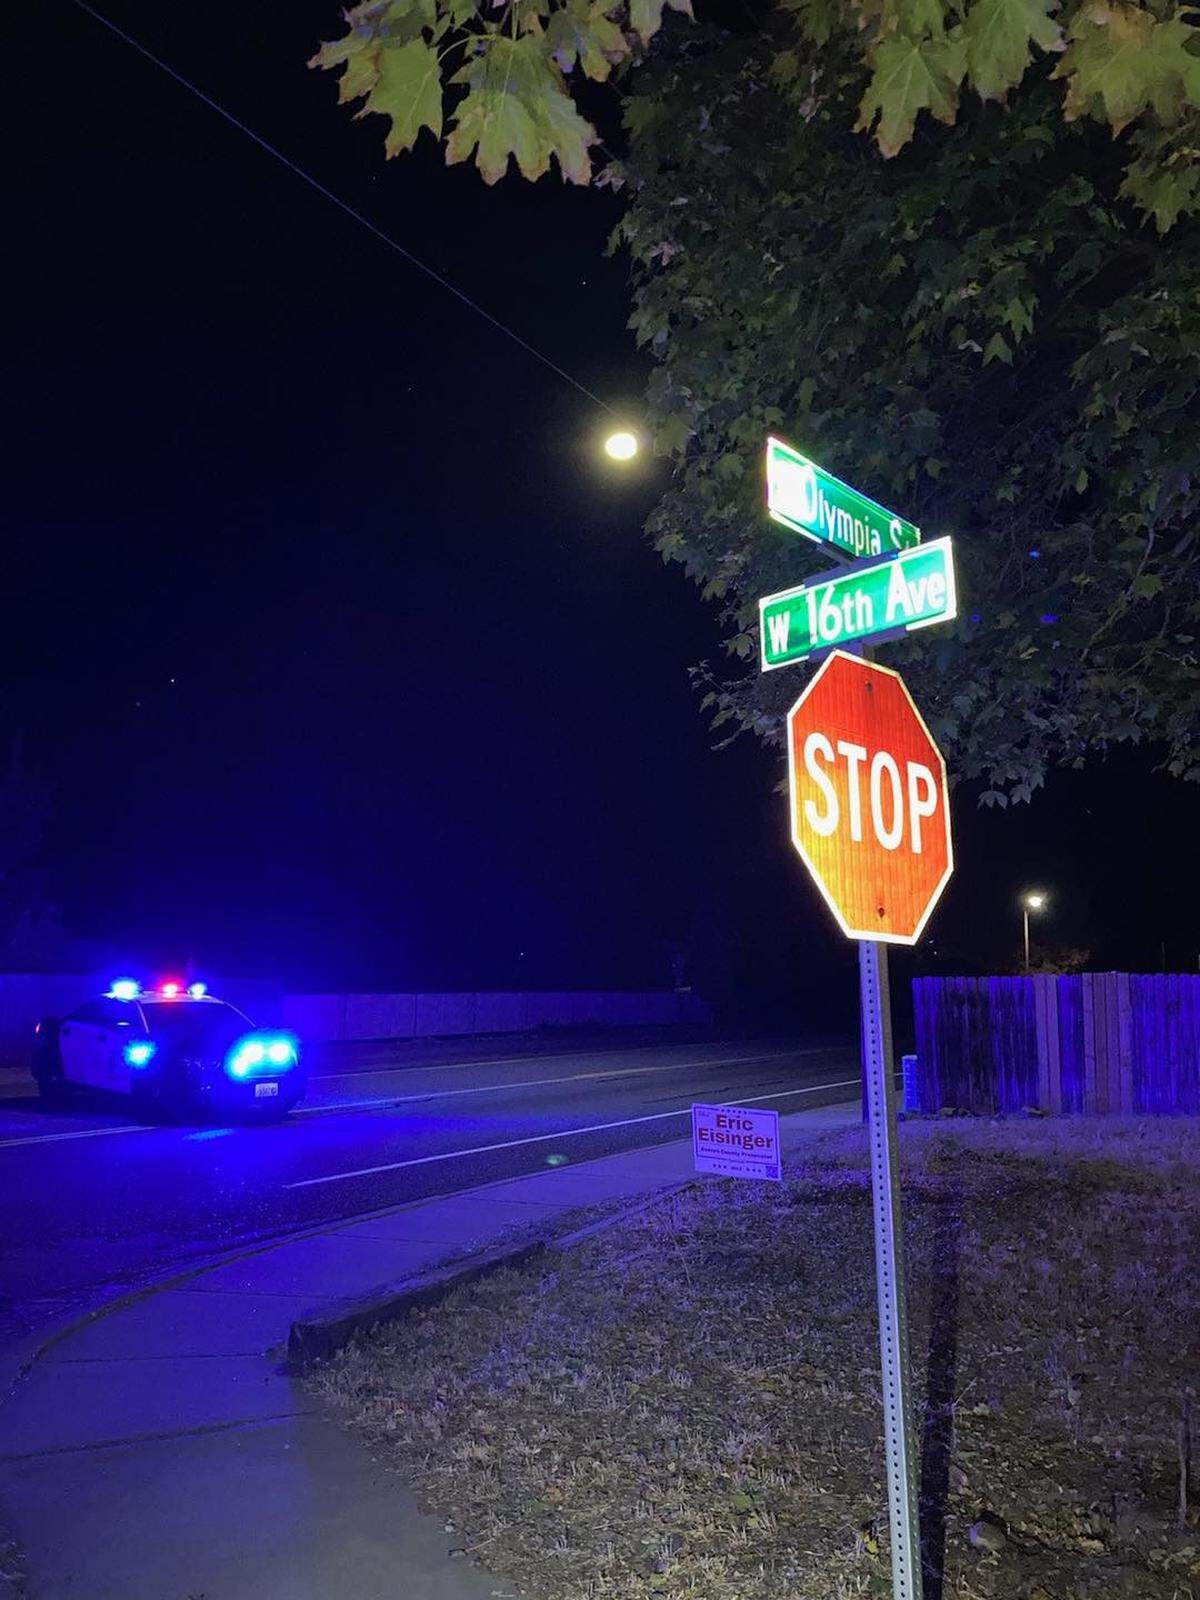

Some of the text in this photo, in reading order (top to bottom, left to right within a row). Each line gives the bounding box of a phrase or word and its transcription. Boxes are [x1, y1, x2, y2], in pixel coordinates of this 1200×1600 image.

[800, 464, 881, 557] Olympia
[889, 518, 911, 550] S
[767, 560, 946, 656] W 16th Ave
[803, 731, 938, 855] STOP
[698, 1127, 774, 1150] Eisinger
[716, 1113, 754, 1131] Eric
